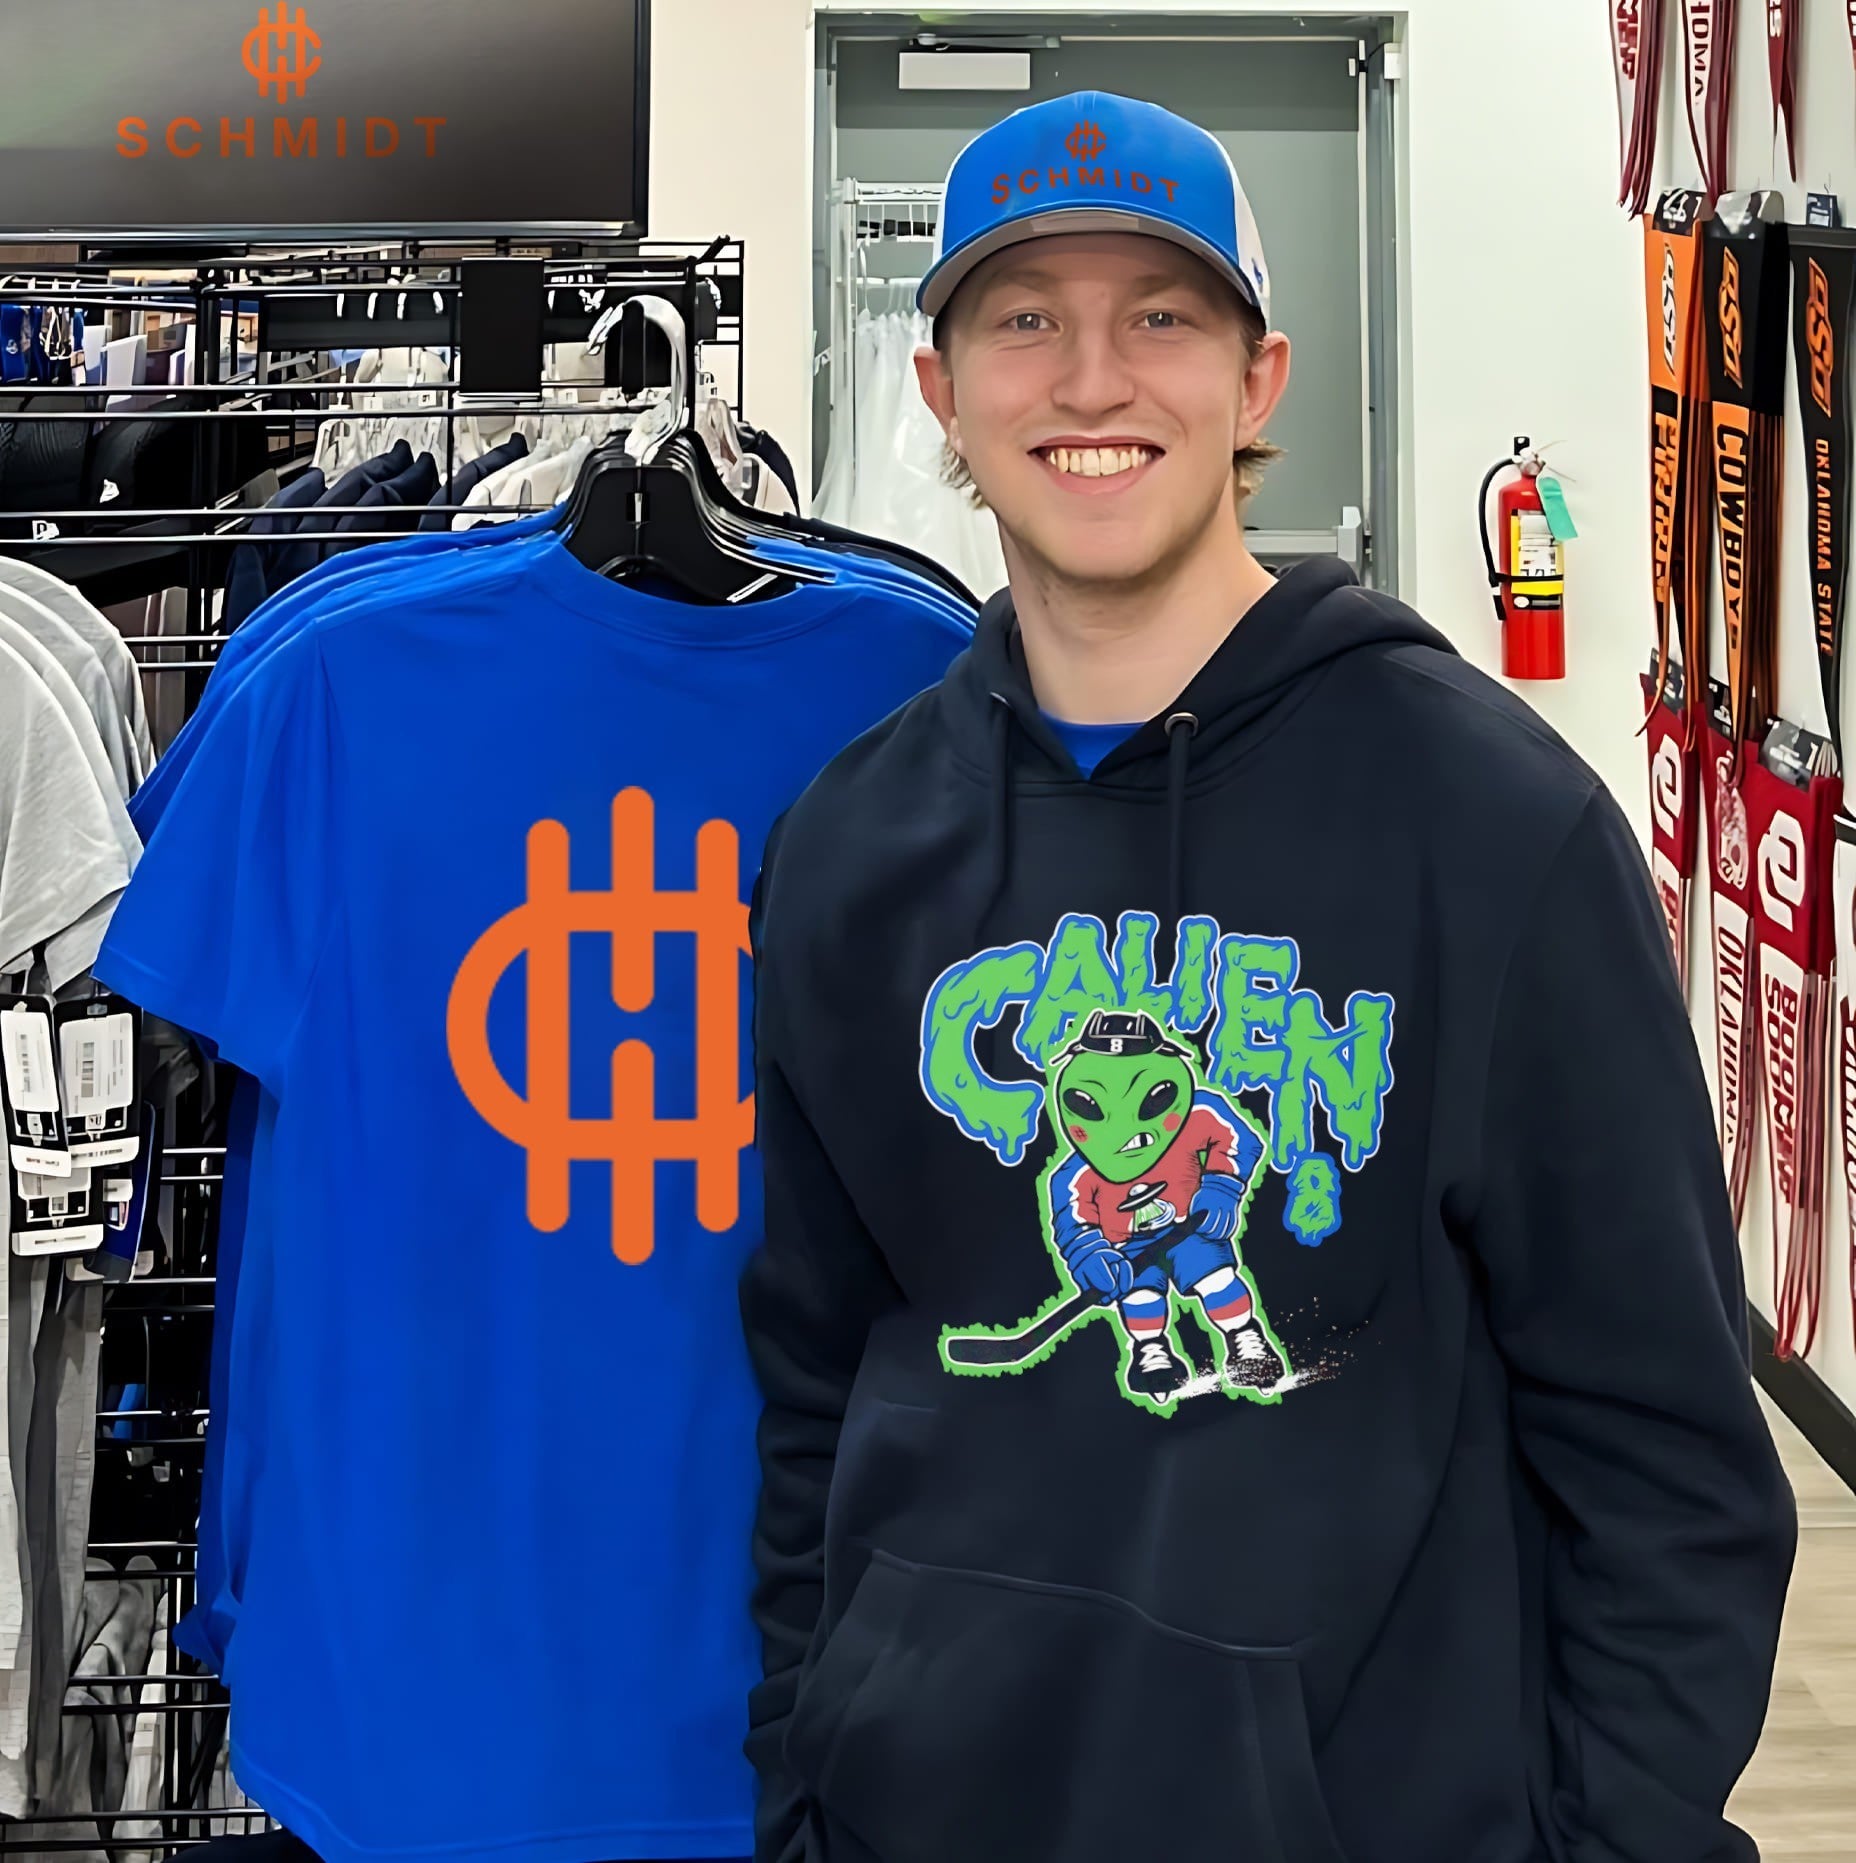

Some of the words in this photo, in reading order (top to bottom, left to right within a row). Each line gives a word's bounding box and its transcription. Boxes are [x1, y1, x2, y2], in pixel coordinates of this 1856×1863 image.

[116, 117, 447, 158] SCHMIDT
[992, 167, 1179, 205] SCHMIDT
[1815, 438, 1832, 570] OKLAHOMA
[1110, 1038, 1123, 1053] 8
[1281, 1157, 1343, 1249] 8
